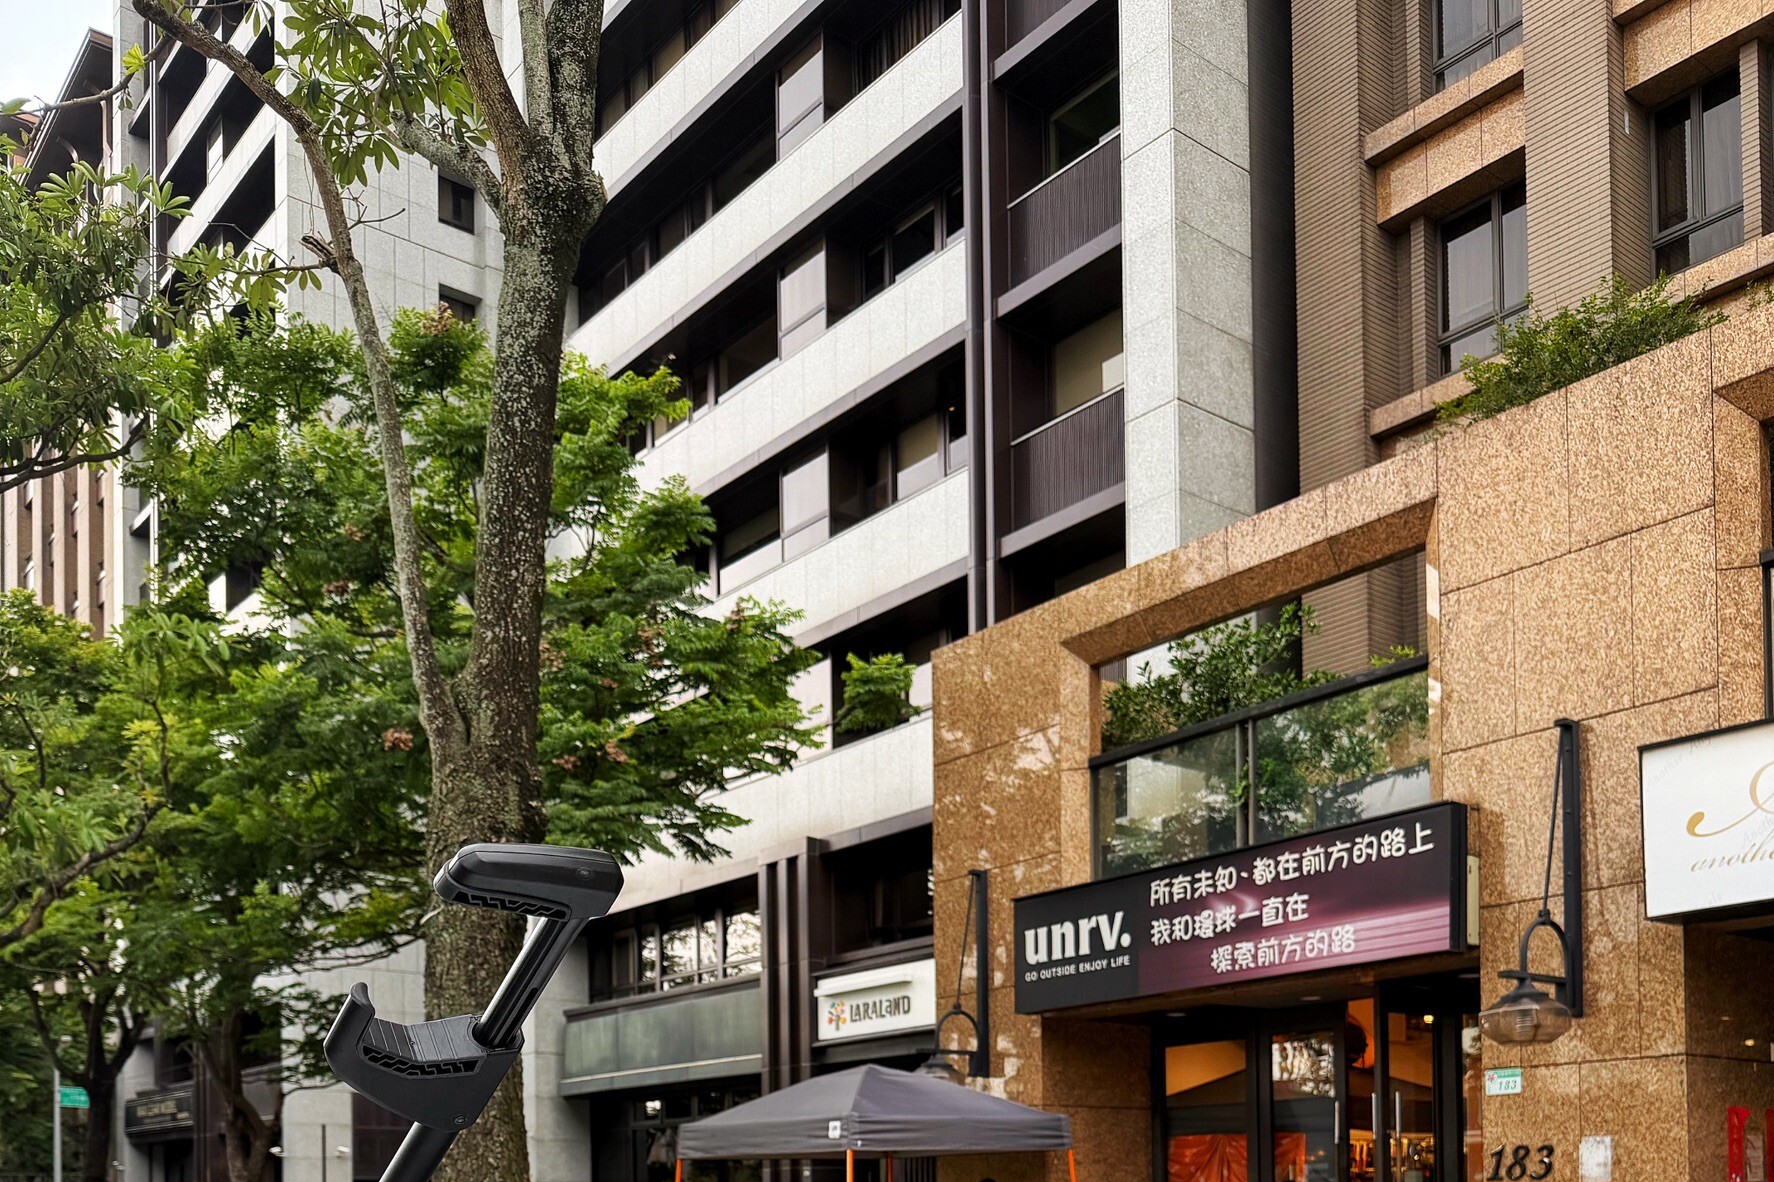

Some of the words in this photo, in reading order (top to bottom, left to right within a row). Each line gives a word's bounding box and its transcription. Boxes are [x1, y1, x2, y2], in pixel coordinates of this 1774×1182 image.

[1149, 821, 1435, 908] 所有未知、都在前方的路上
[1024, 910, 1132, 966] unrv.
[1150, 892, 1310, 946] 我和環球一直在
[1024, 970, 1039, 982] GO
[1040, 964, 1077, 980] OUTSIDE
[1079, 959, 1109, 973] ENJOY
[1110, 954, 1131, 968] LIFE
[1210, 924, 1356, 974] 探索前方的路
[1499, 1079, 1518, 1091] 183
[1486, 1144, 1554, 1182] 183
